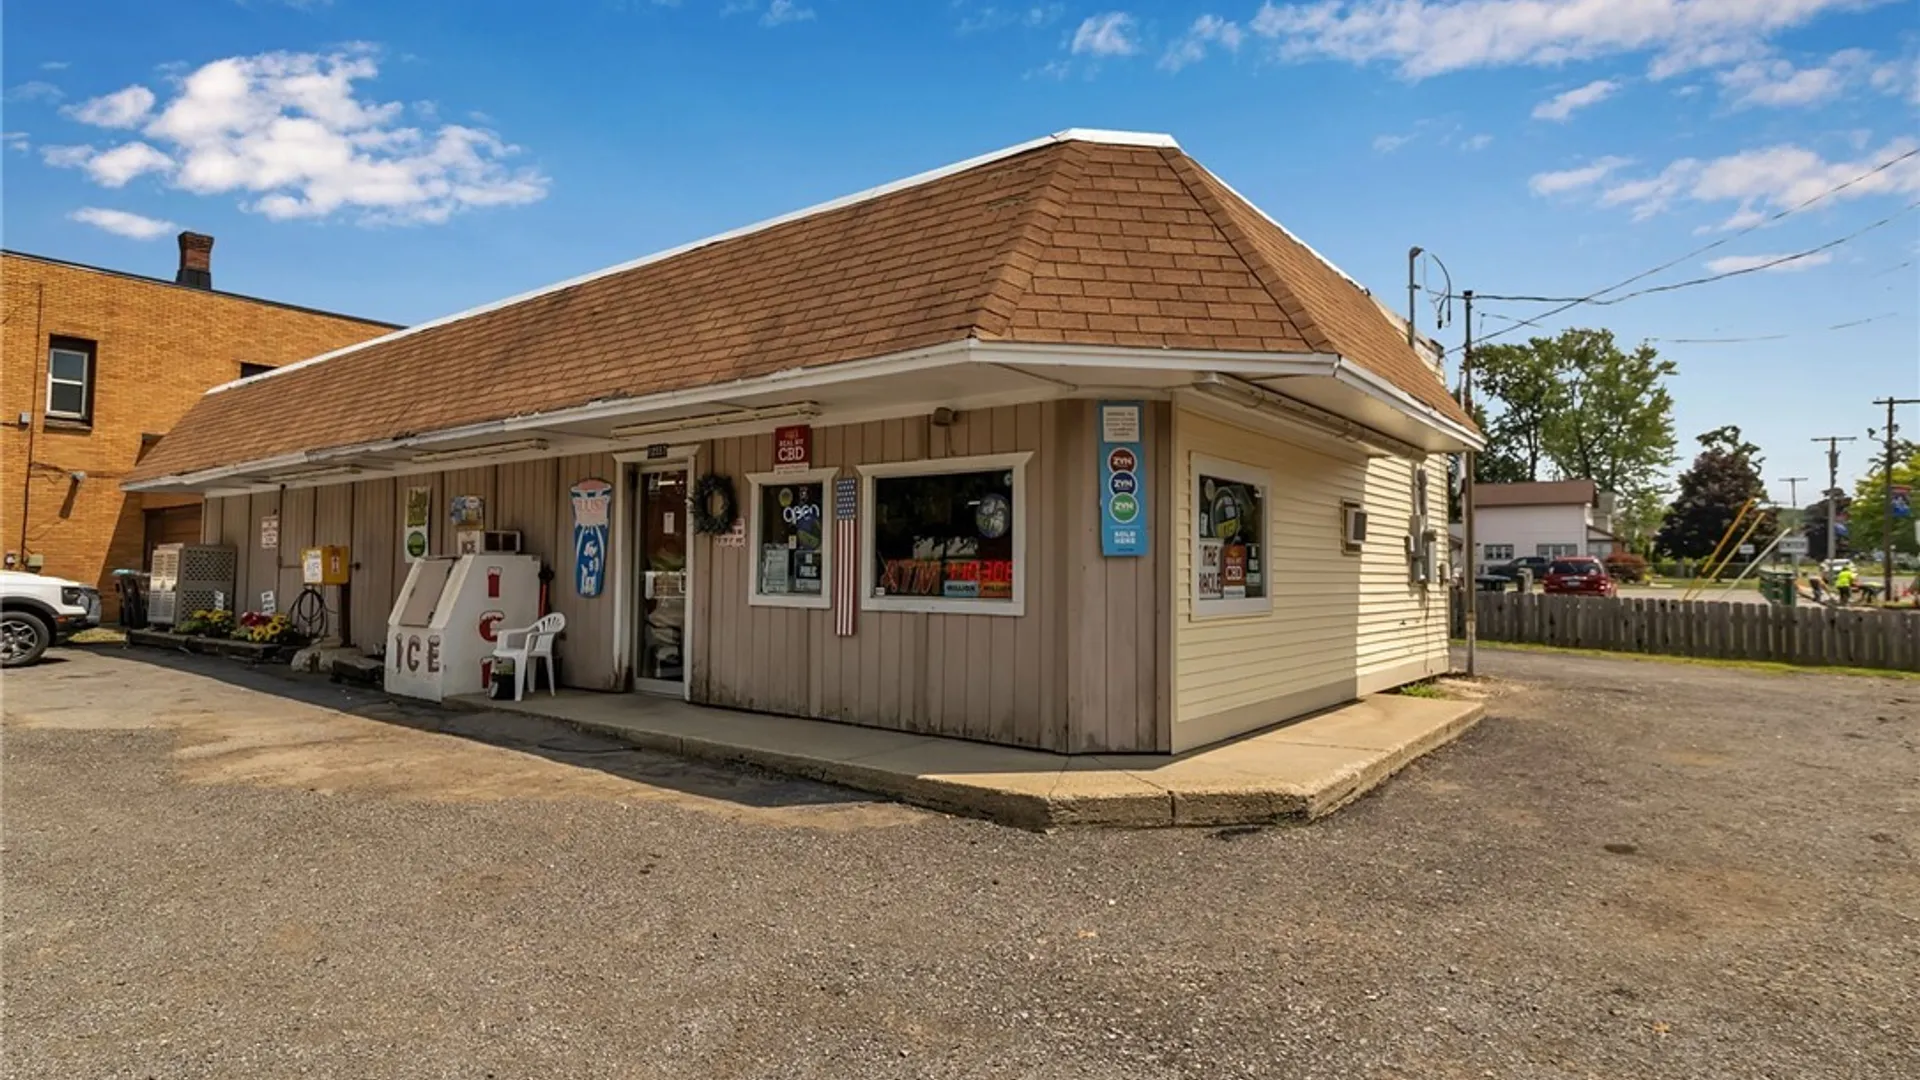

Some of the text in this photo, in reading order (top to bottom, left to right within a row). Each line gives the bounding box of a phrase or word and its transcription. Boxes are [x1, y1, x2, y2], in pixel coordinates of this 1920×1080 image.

[778, 446, 804, 461] CBD
[1112, 457, 1133, 465] ZYN
[1114, 480, 1133, 488] ZYN
[1114, 502, 1134, 511] ZYN
[880, 559, 941, 594] ATM
[395, 633, 441, 674] ICE
